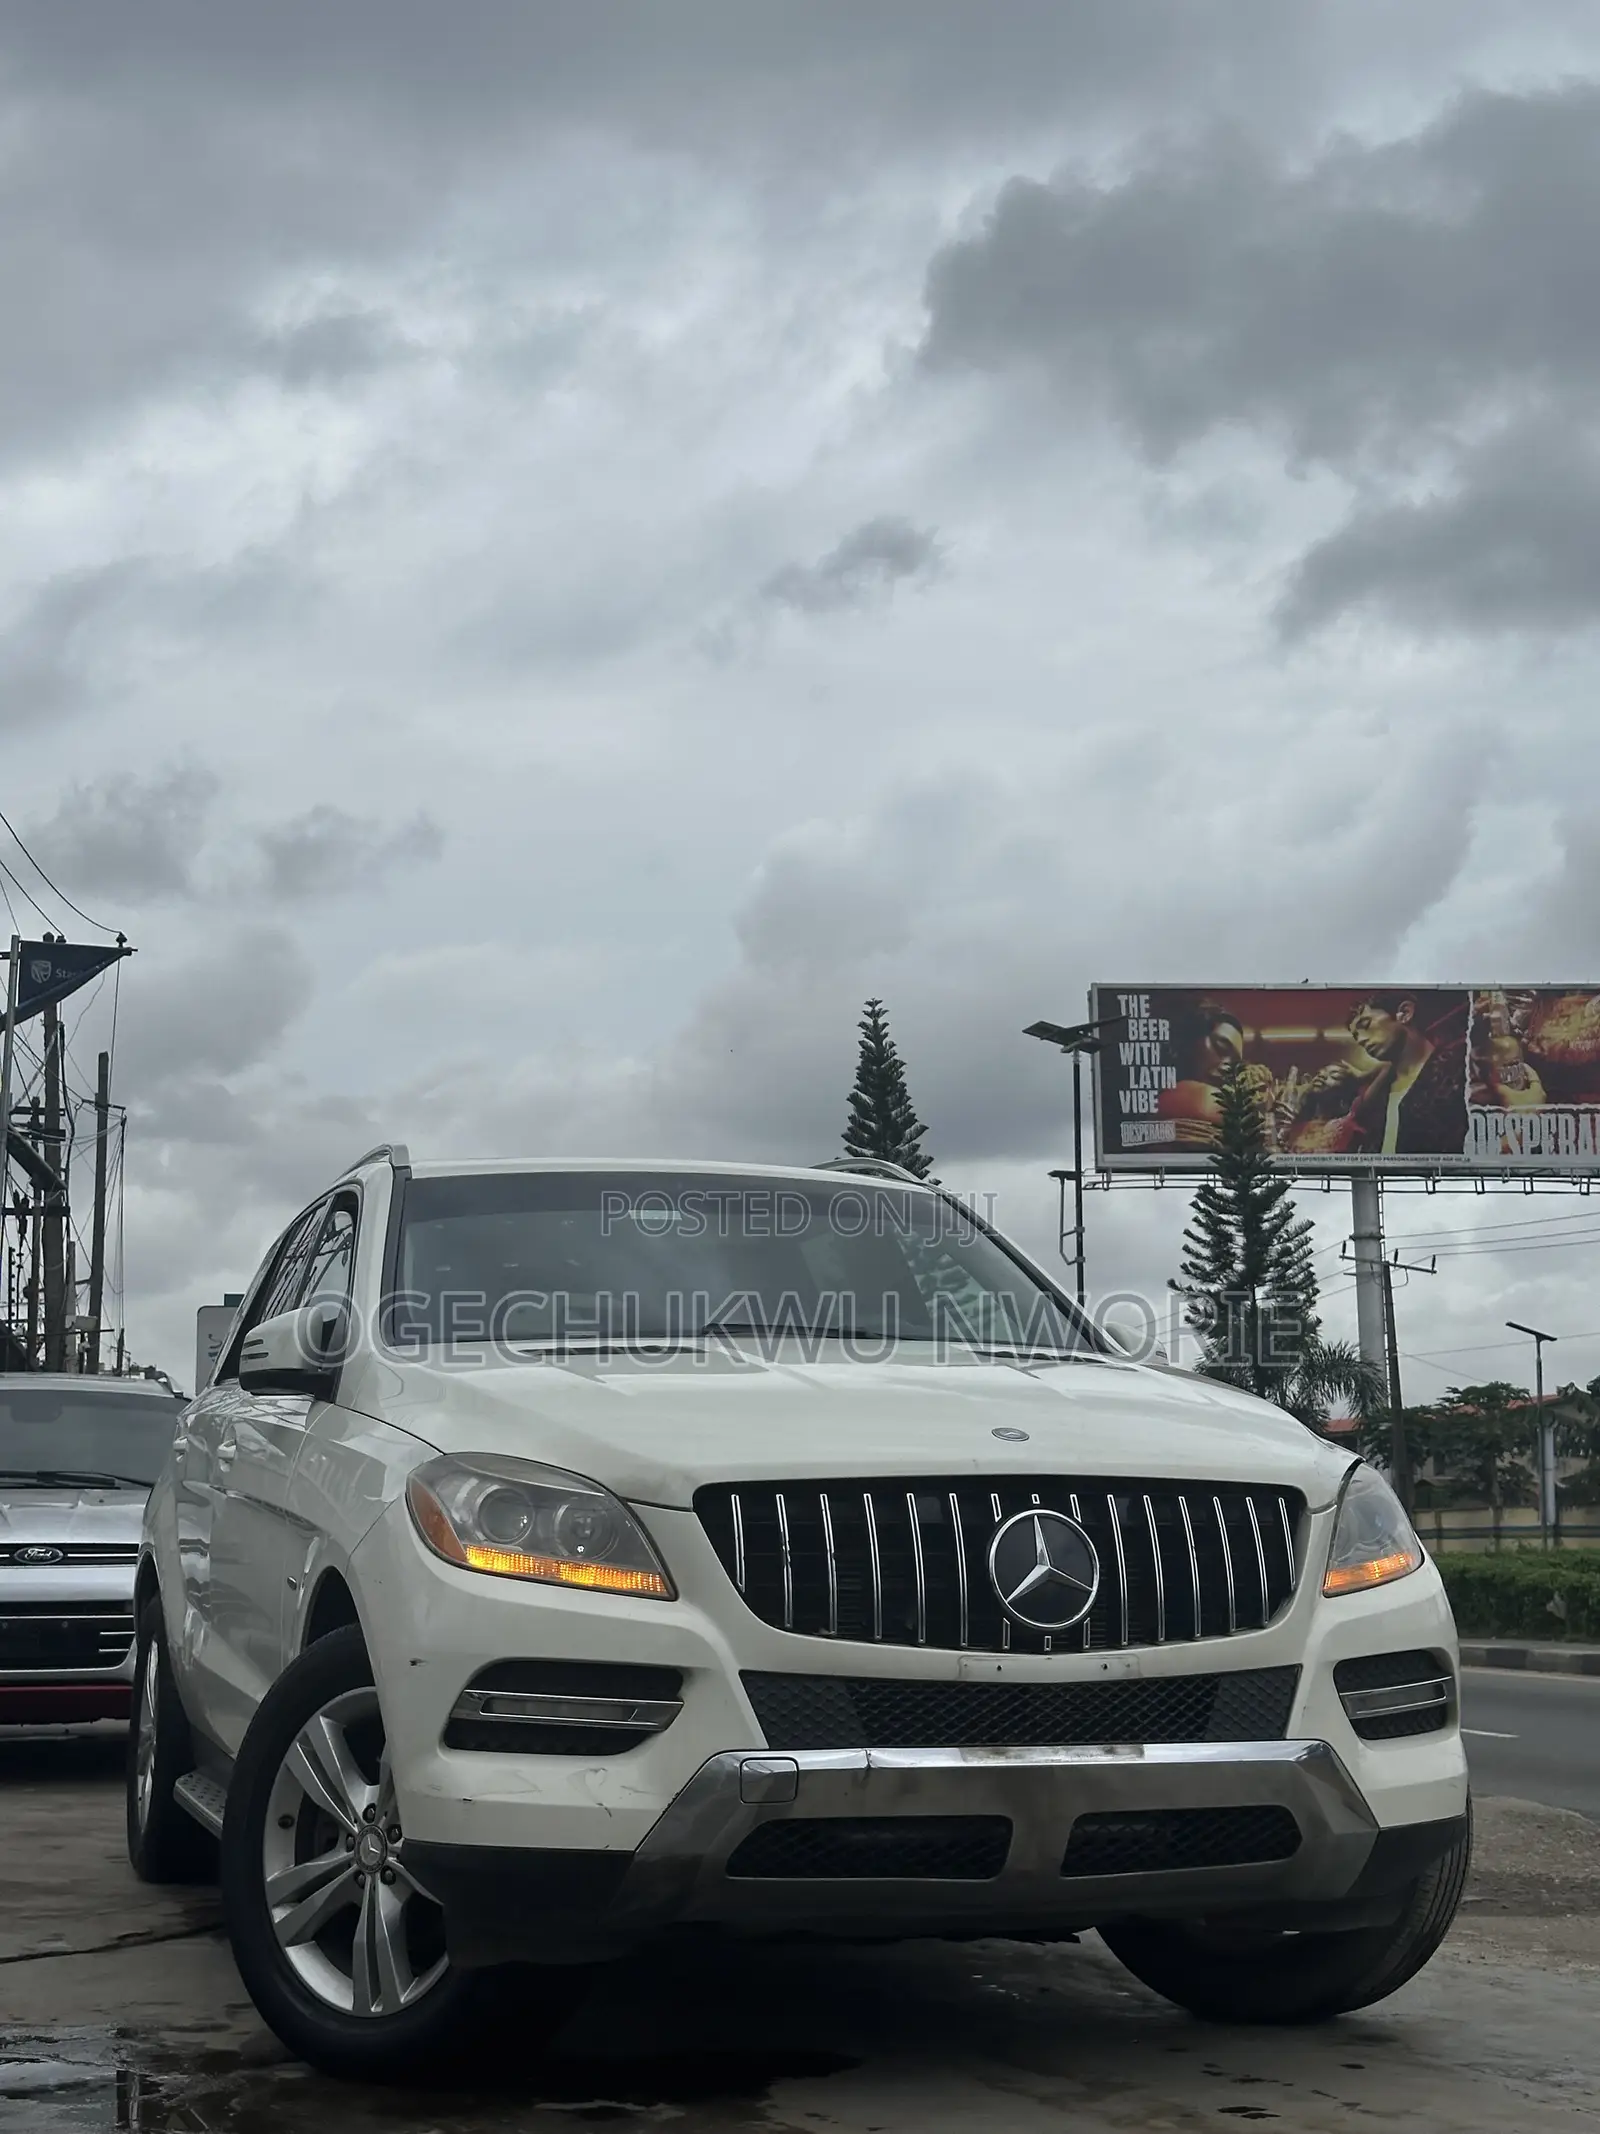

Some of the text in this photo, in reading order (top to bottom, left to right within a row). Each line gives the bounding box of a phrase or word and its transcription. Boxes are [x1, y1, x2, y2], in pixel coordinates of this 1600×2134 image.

[1117, 994, 1151, 1018] THE
[1128, 1018, 1170, 1041] BEER
[1118, 1042, 1161, 1066] WITH
[1129, 1066, 1177, 1089] LATIN
[1118, 1090, 1159, 1114] VIBE
[24, 1548, 52, 1559] Ford
